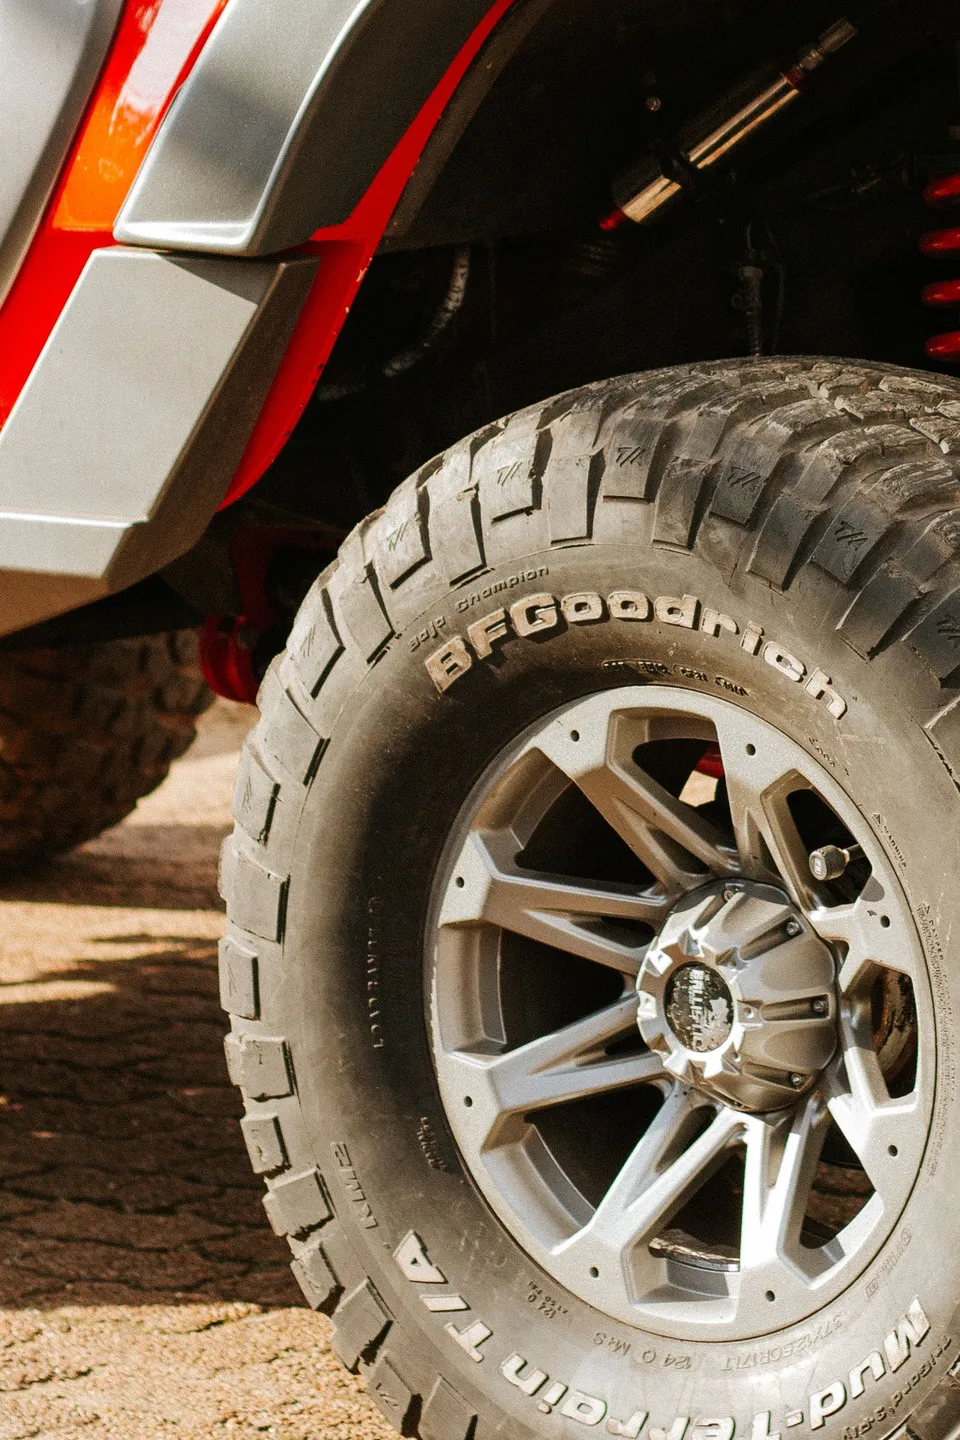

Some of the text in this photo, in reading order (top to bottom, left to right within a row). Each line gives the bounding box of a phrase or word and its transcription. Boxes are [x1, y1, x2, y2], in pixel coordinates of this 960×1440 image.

[424, 591, 848, 721] BFGoodrich
[455, 566, 550, 614] Champion
[392, 1228, 494, 1364] T/A
[500, 1294, 932, 1440] Mud-Terrain
